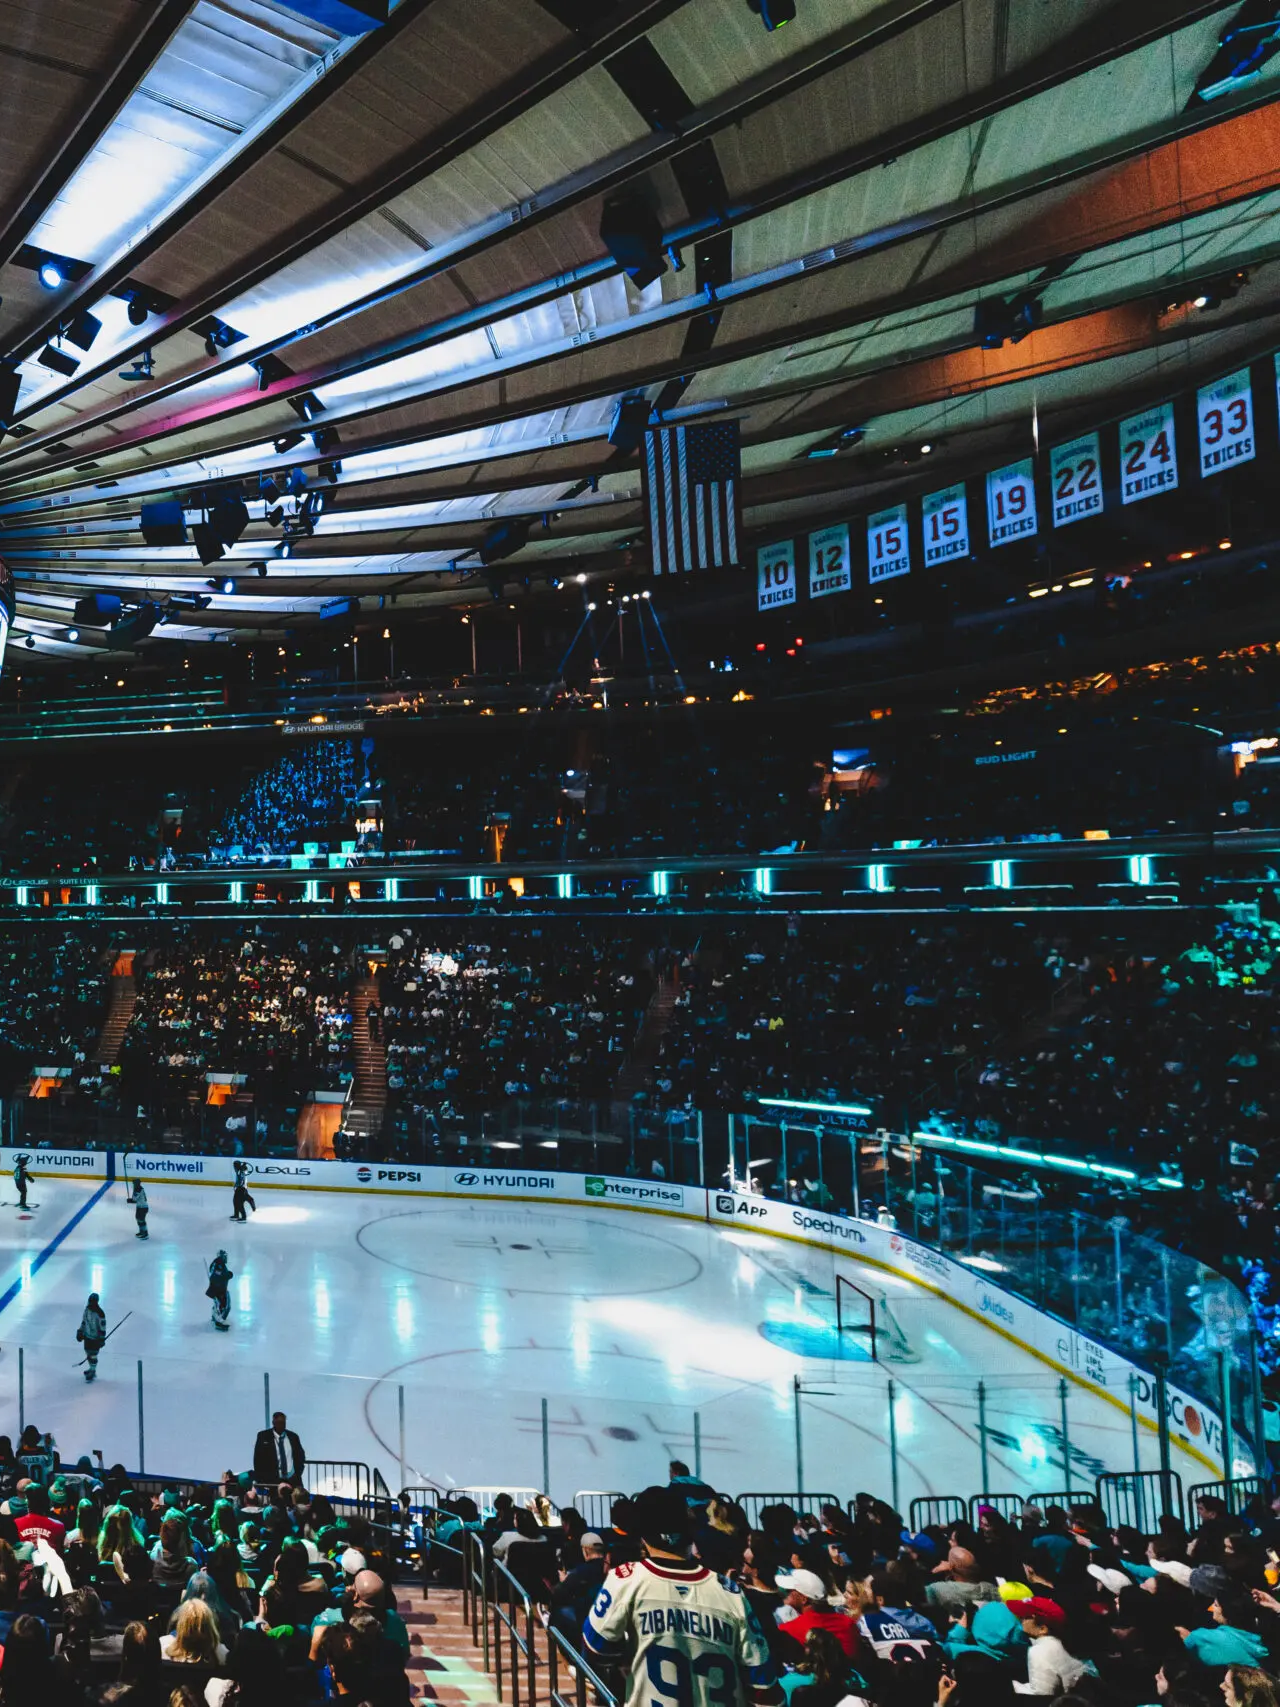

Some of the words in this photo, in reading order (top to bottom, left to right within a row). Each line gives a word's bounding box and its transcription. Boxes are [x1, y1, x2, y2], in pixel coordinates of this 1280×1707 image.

[1204, 399, 1247, 445] 33
[1124, 431, 1170, 475] 24
[1204, 438, 1252, 469] KNICKS
[1055, 459, 1097, 500] 22
[1126, 468, 1174, 496] KNICKS
[996, 485, 1026, 520] 19
[1056, 494, 1100, 520] KNICKS
[930, 508, 959, 542] 15
[992, 517, 1034, 541] KNICKS
[875, 528, 901, 558] 15
[928, 539, 966, 561] KNICKS
[816, 546, 843, 576] 12
[872, 557, 908, 578] KNICKS
[764, 560, 788, 588] 10
[812, 574, 848, 593] KNICKS
[760, 588, 794, 606] KNICKS
[298, 724, 334, 732] HYUNDAI
[976, 756, 1000, 765] BUD
[1002, 750, 1036, 762] LIGHT
[819, 1115, 868, 1128] ULTRA
[36, 1155, 95, 1167] HYUNDAI
[136, 1159, 204, 1173] Northwell
[255, 1166, 311, 1176] LEXUS
[378, 1170, 421, 1182] PEPSI
[484, 1175, 555, 1189] HYUNDAI
[793, 1211, 862, 1243] Spectrum
